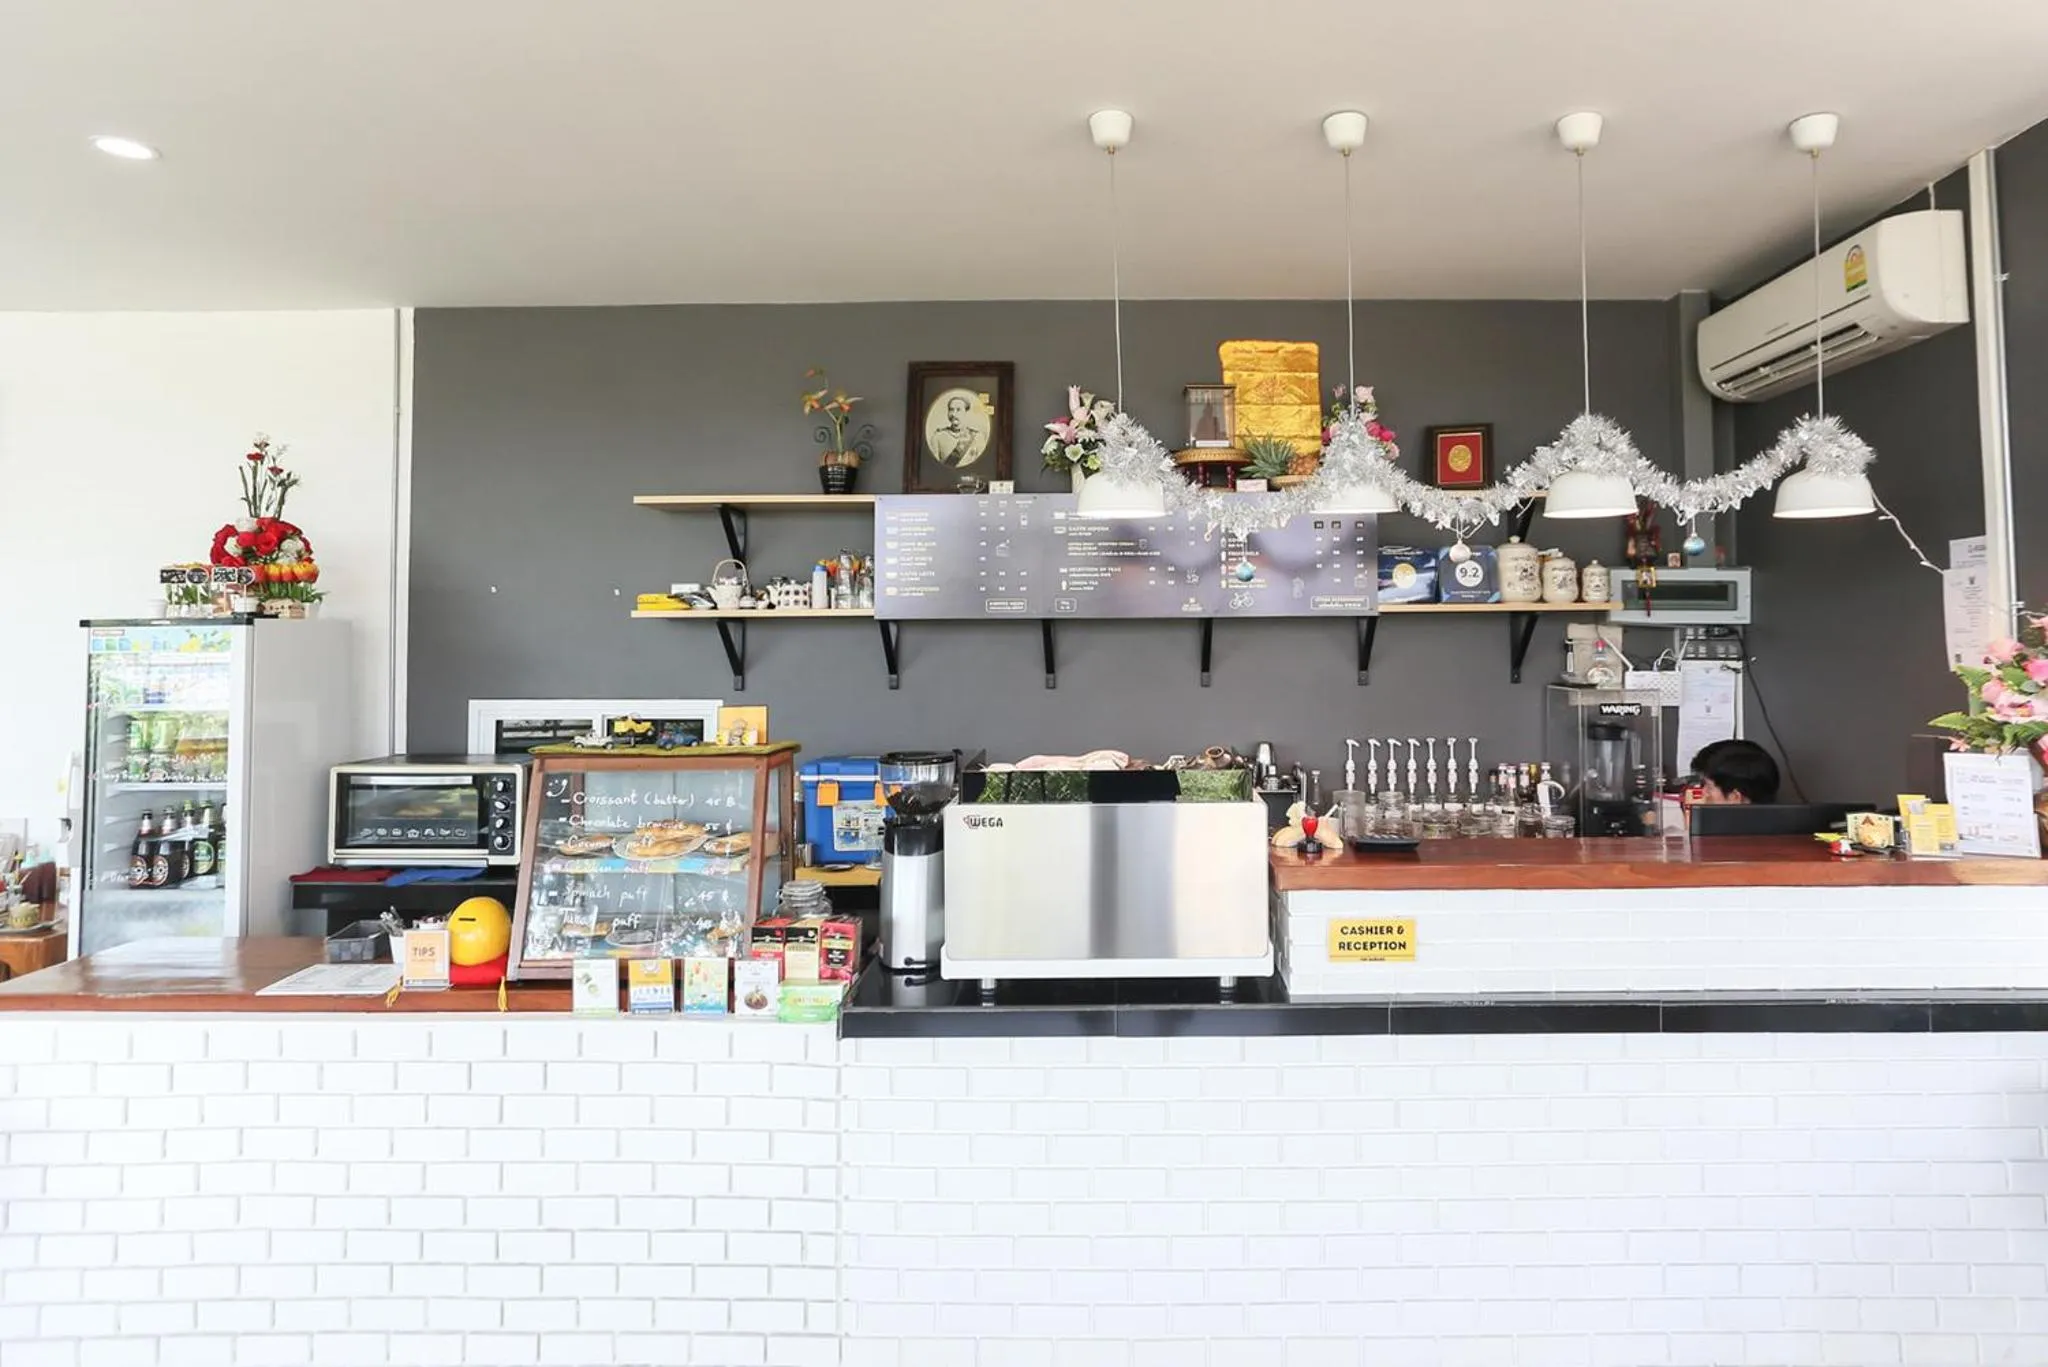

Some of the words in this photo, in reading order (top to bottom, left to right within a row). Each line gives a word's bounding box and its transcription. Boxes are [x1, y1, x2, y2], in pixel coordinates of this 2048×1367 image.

[1460, 567, 1480, 579] 9.2
[1601, 704, 1641, 716] WARING
[573, 789, 637, 806] Croissant
[970, 817, 1004, 828] WEGA
[625, 833, 657, 856] puff
[619, 886, 649, 908] puff
[612, 912, 642, 933] puff
[1340, 926, 1394, 936] CASHIER
[1397, 925, 1405, 935] &
[412, 947, 436, 957] TIPS
[1338, 941, 1407, 951] RECEPTION
